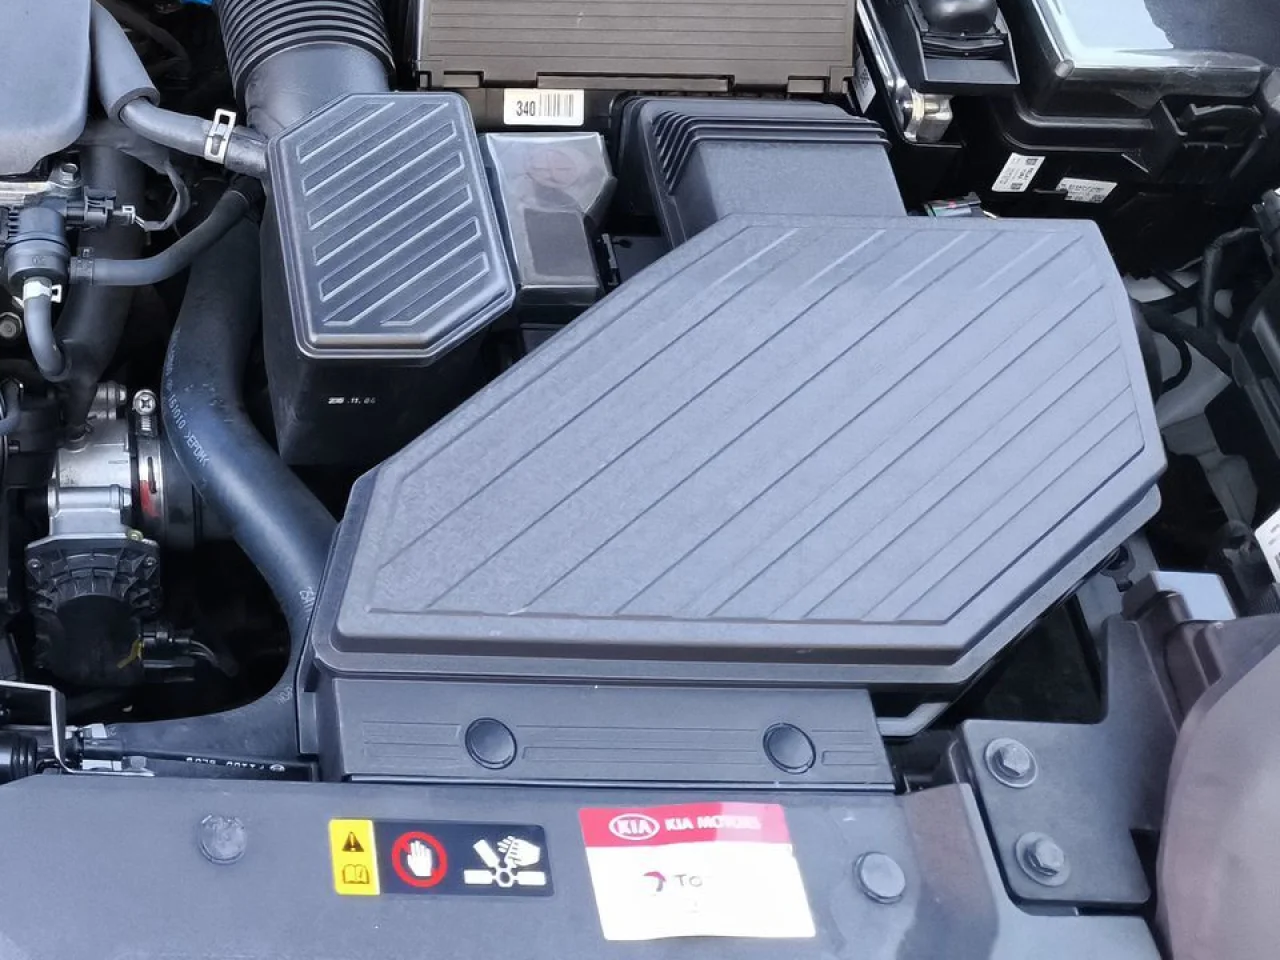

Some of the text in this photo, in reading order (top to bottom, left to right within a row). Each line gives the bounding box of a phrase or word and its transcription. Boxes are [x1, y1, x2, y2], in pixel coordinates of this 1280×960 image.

[516, 101, 536, 117] 340
[617, 815, 761, 835] KIA KIA MOTORS
